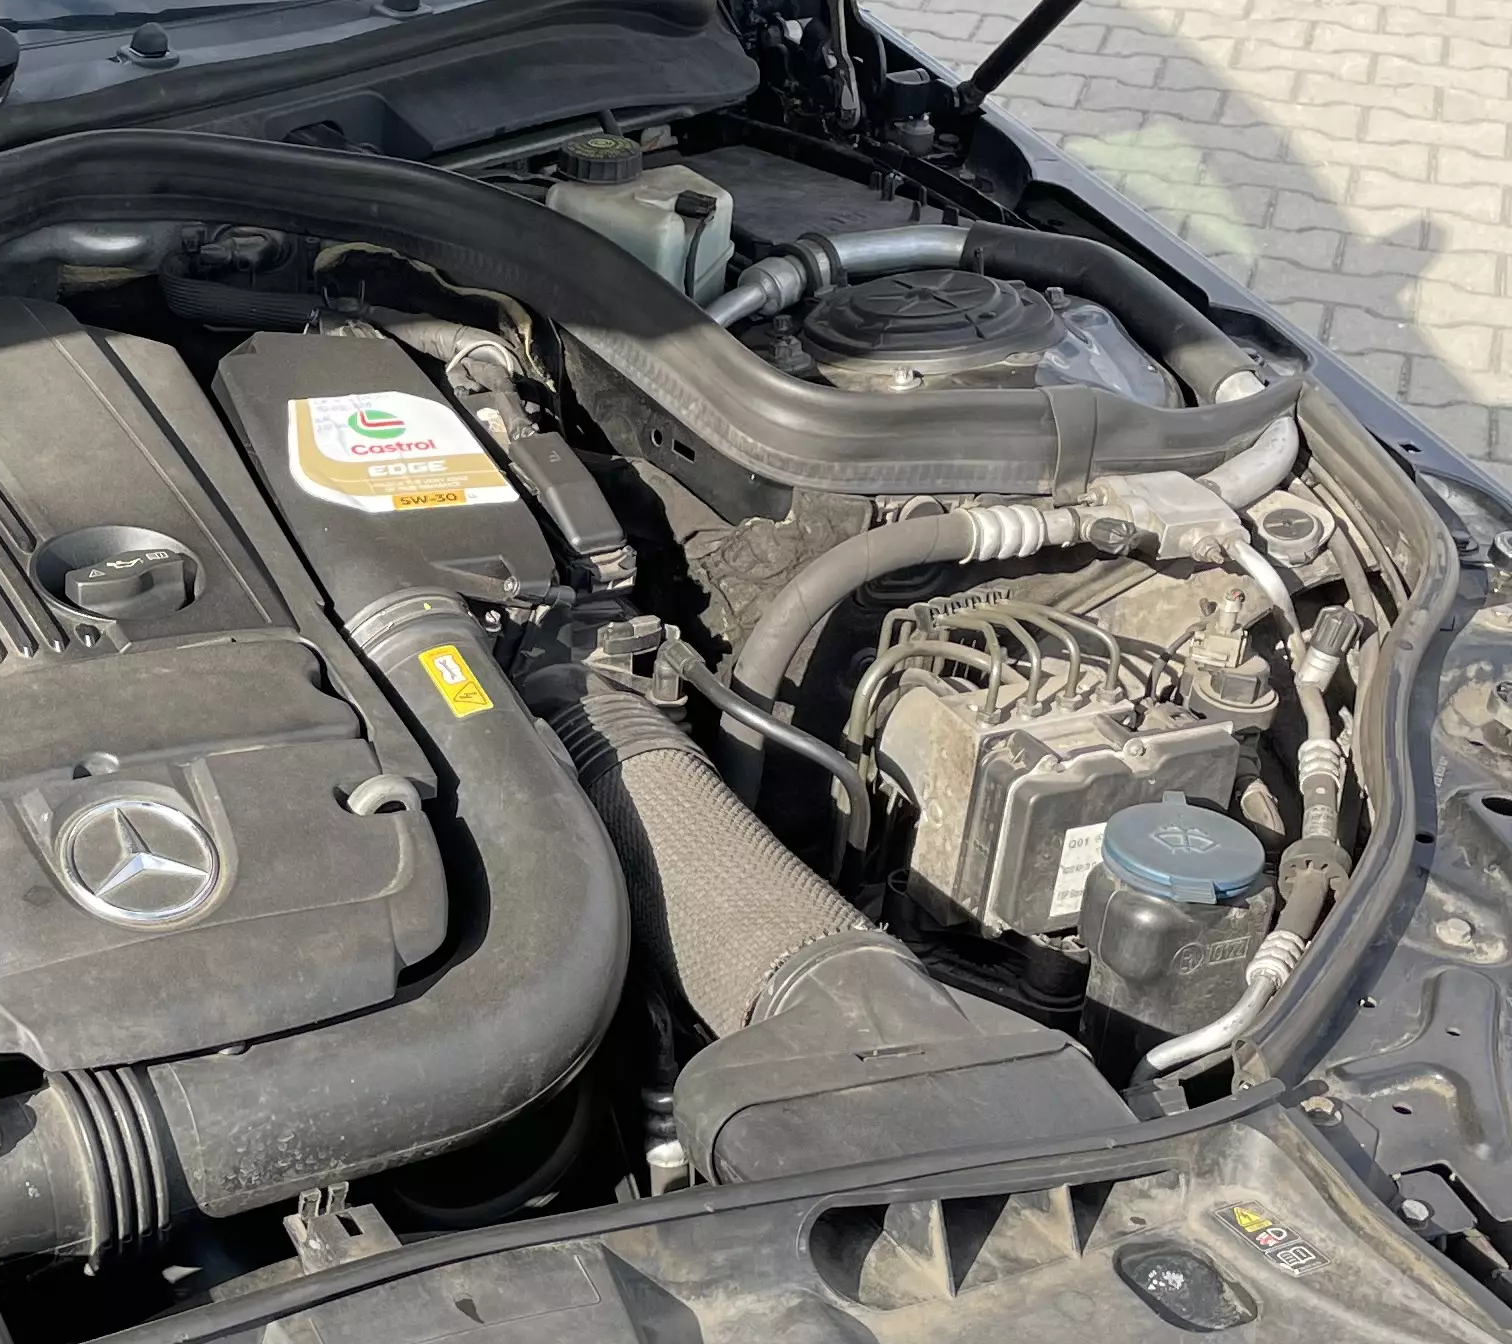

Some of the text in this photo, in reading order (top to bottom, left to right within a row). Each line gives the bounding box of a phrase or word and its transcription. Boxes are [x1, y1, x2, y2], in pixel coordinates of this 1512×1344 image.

[351, 439, 437, 456] Castrol
[368, 460, 448, 477] EDGE
[400, 493, 458, 506] 5W-30
[1068, 837, 1090, 849] Q01
